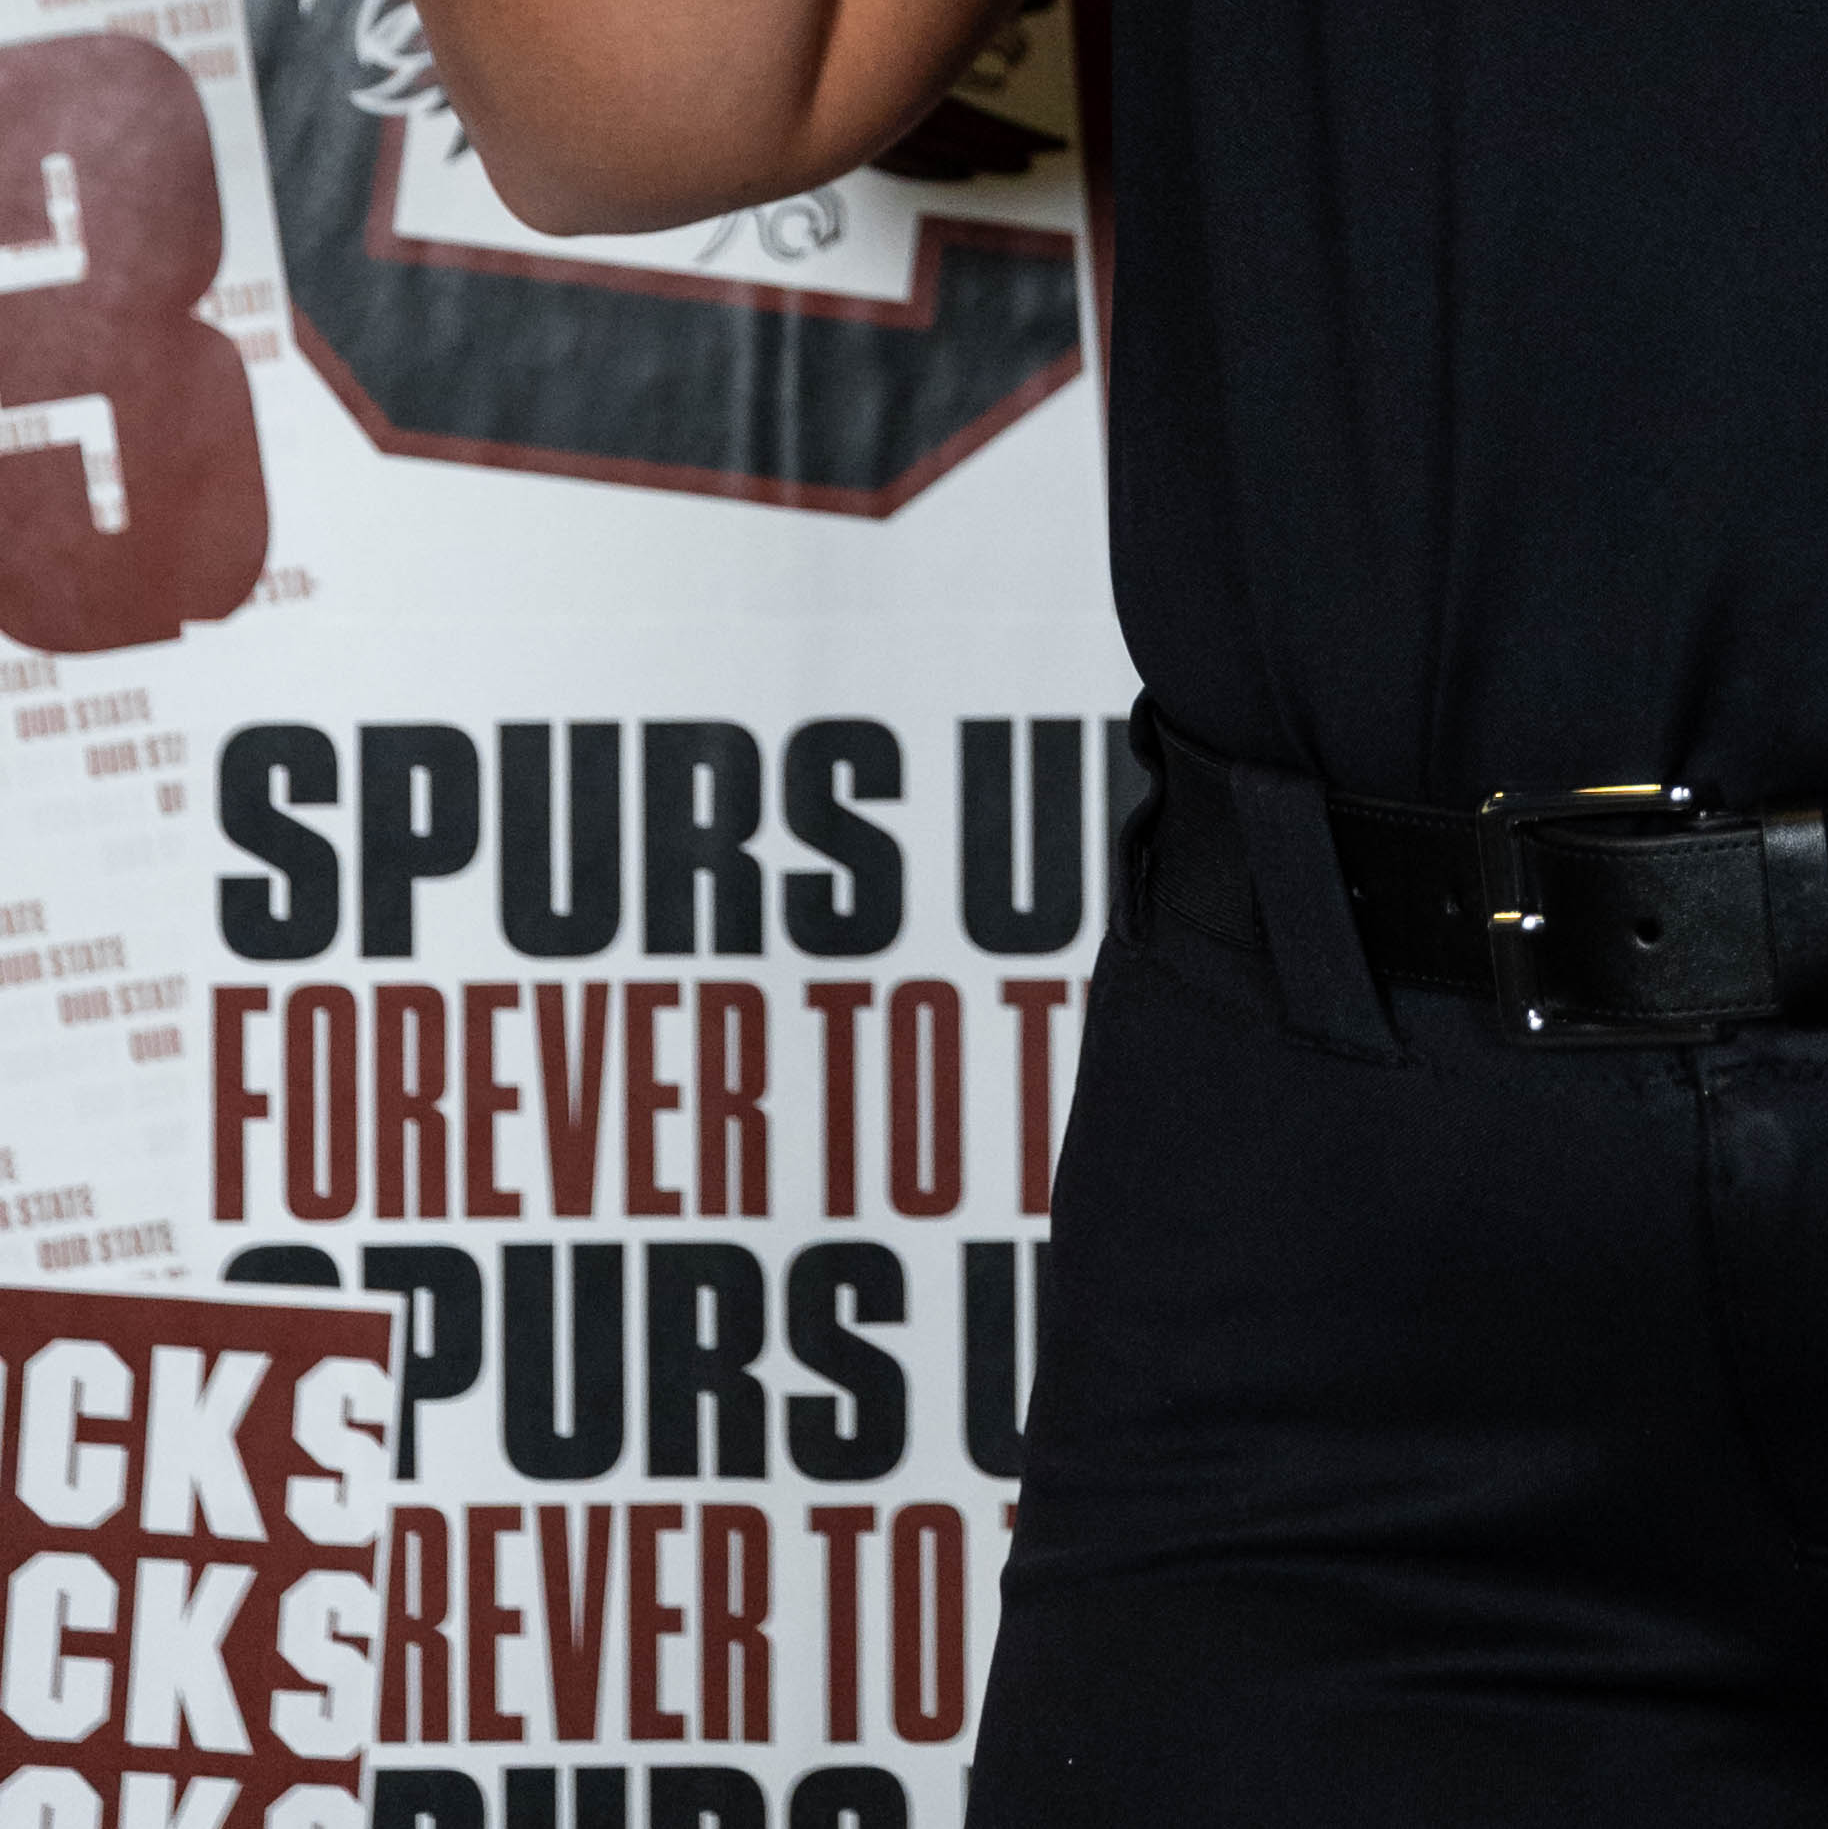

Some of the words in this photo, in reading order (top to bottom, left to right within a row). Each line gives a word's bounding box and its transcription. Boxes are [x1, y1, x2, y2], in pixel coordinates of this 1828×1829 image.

[216, 719, 908, 961] SPURS
[211, 980, 773, 1221] FOREVER
[804, 979, 965, 1220] TO
[221, 1241, 909, 1483] PURS
[806, 1502, 968, 1744] TO
